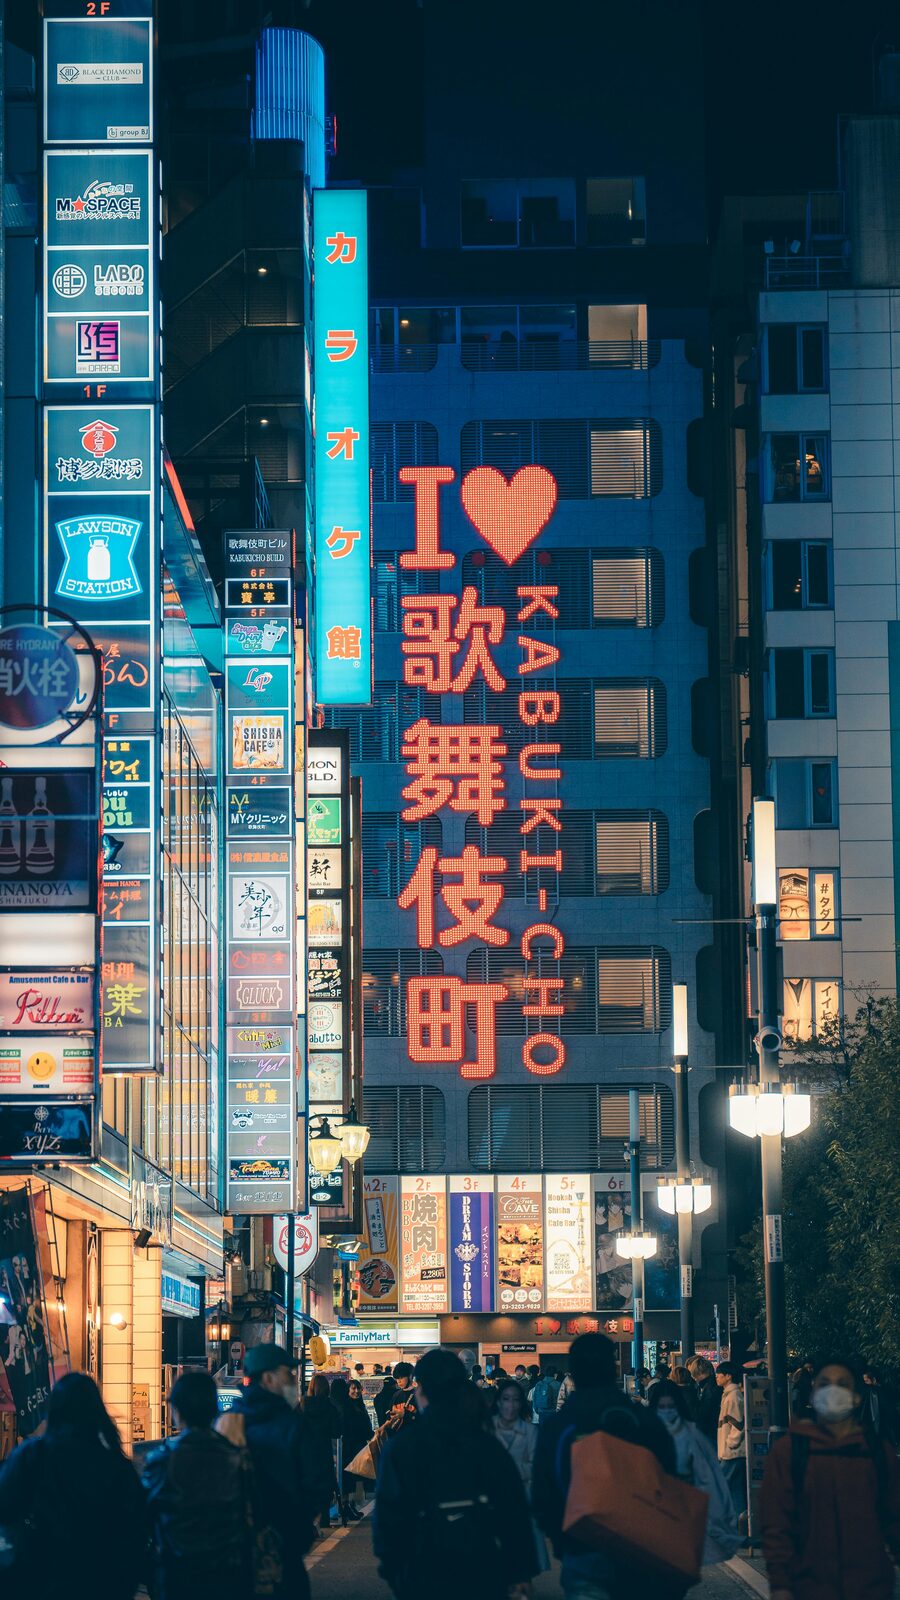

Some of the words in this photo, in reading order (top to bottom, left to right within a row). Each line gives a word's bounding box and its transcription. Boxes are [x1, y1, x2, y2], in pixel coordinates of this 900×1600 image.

[86, 2, 111, 15] 2F
[119, 129, 139, 137] group
[94, 264, 144, 283] LABO
[94, 286, 144, 296] SECOND
[83, 385, 107, 398] 1F
[325, 231, 362, 662] カラオケ館
[55, 457, 144, 482] 博多劇場
[398, 465, 456, 571] I
[64, 521, 135, 538] LAWSON
[229, 538, 287, 550] 歌舞伎町ビル
[250, 569, 266, 578] 6F
[65, 577, 134, 595] STATION
[250, 608, 266, 617] 5F
[16, 639, 60, 651] HYDRANT
[243, 728, 283, 740] SHISHA
[243, 740, 269, 752] CAFE
[397, 585, 510, 1080] 歌舞伎町
[516, 584, 567, 1076] KABUKI-CHO
[9, 976, 52, 984] Amusement
[52, 976, 68, 984] Cafe
[76, 976, 90, 984] Bar
[330, 988, 341, 998] 3F
[415, 1178, 431, 1191] 2F
[463, 1177, 479, 1191] 3F
[510, 1176, 527, 1190] 4F
[560, 1176, 575, 1190] 5F
[607, 1176, 624, 1190] 6F
[547, 1206, 571, 1214] Shisha
[411, 1193, 438, 1253] 焼肉
[463, 1195, 473, 1242] DREAM
[547, 1218, 563, 1227] Cafe
[482, 1226, 491, 1279] イベントスペース
[463, 1263, 473, 1310] STORE
[339, 1332, 391, 1343] FamilyMart
